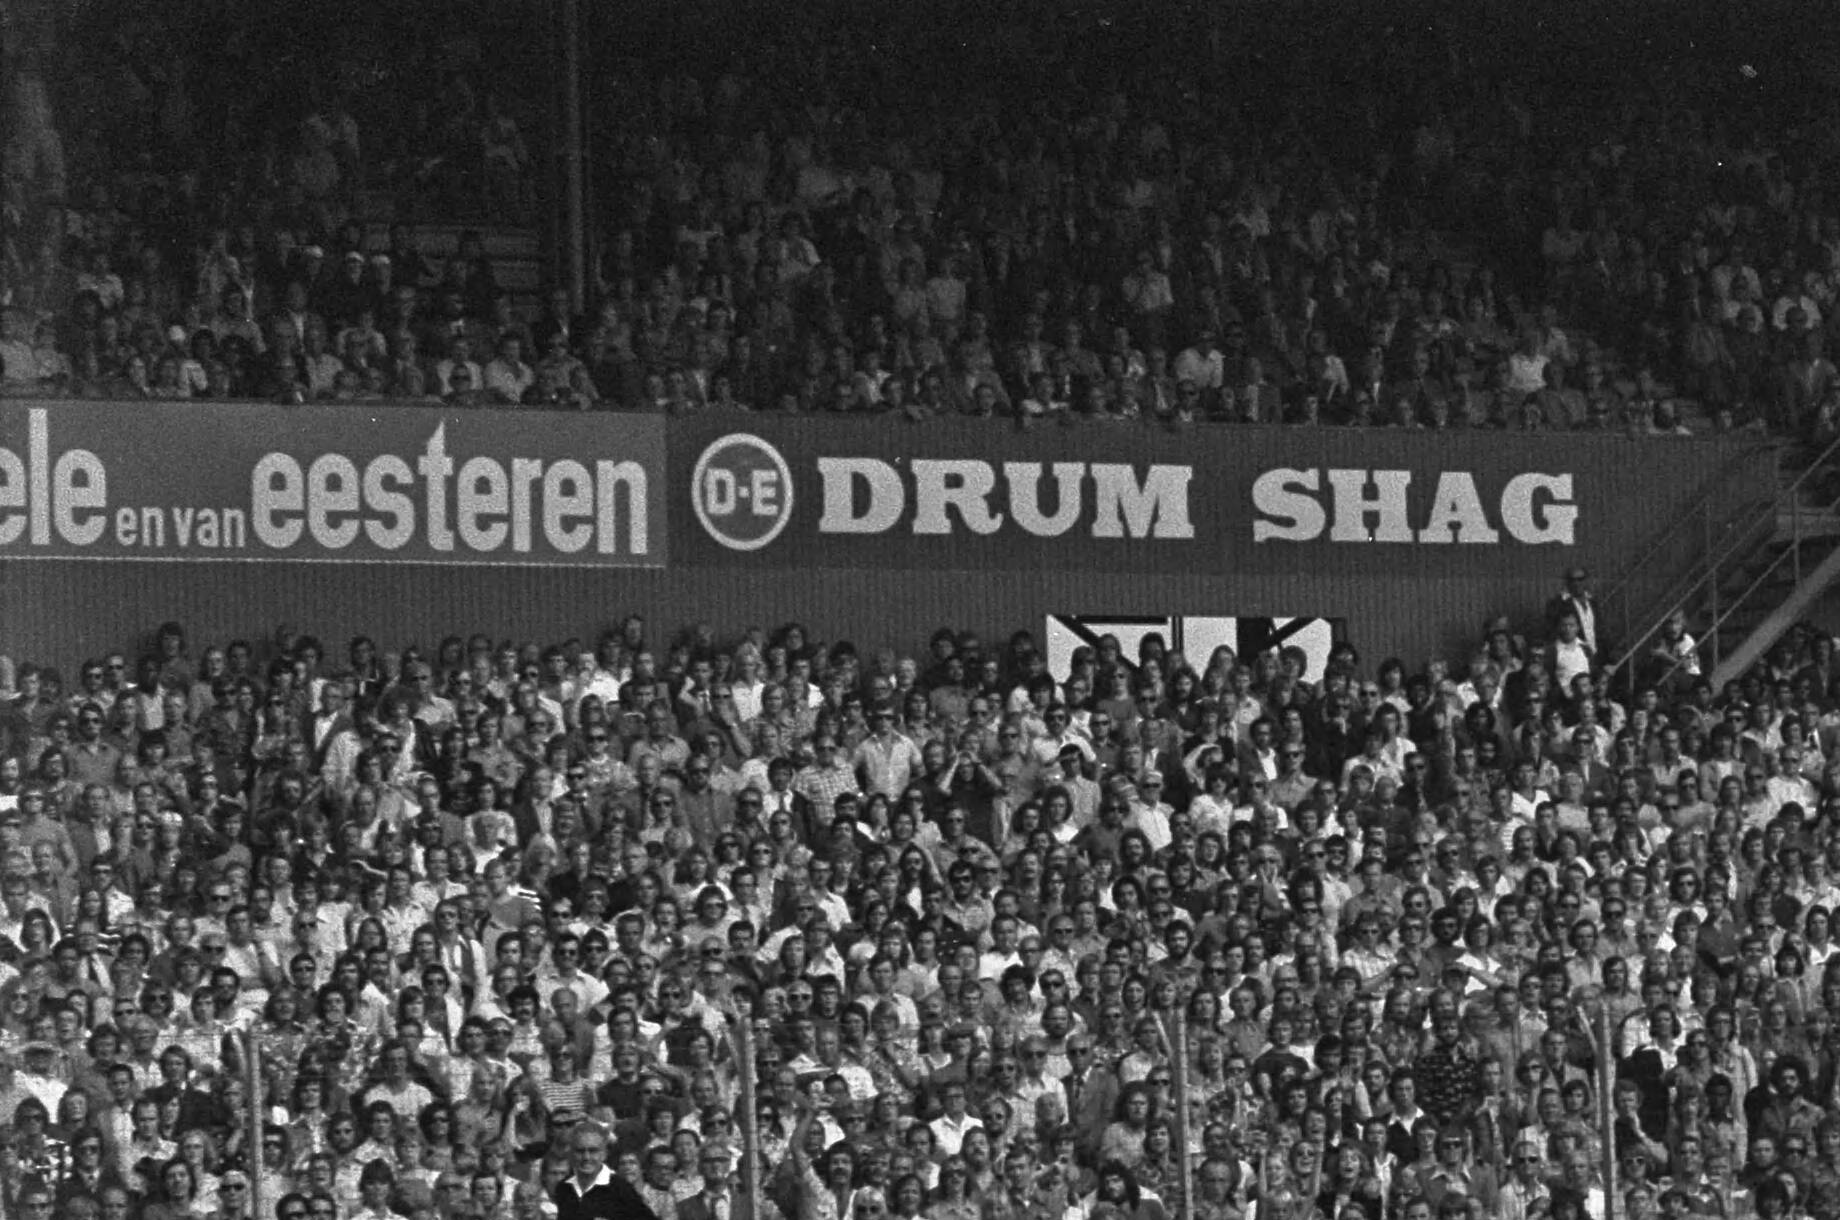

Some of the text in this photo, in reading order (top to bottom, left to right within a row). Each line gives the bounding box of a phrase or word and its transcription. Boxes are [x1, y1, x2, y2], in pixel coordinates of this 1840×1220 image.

[116, 506, 165, 547] en
[173, 506, 246, 548] van
[253, 421, 648, 555] eesteren
[817, 456, 1579, 545] DRUM SHAG
